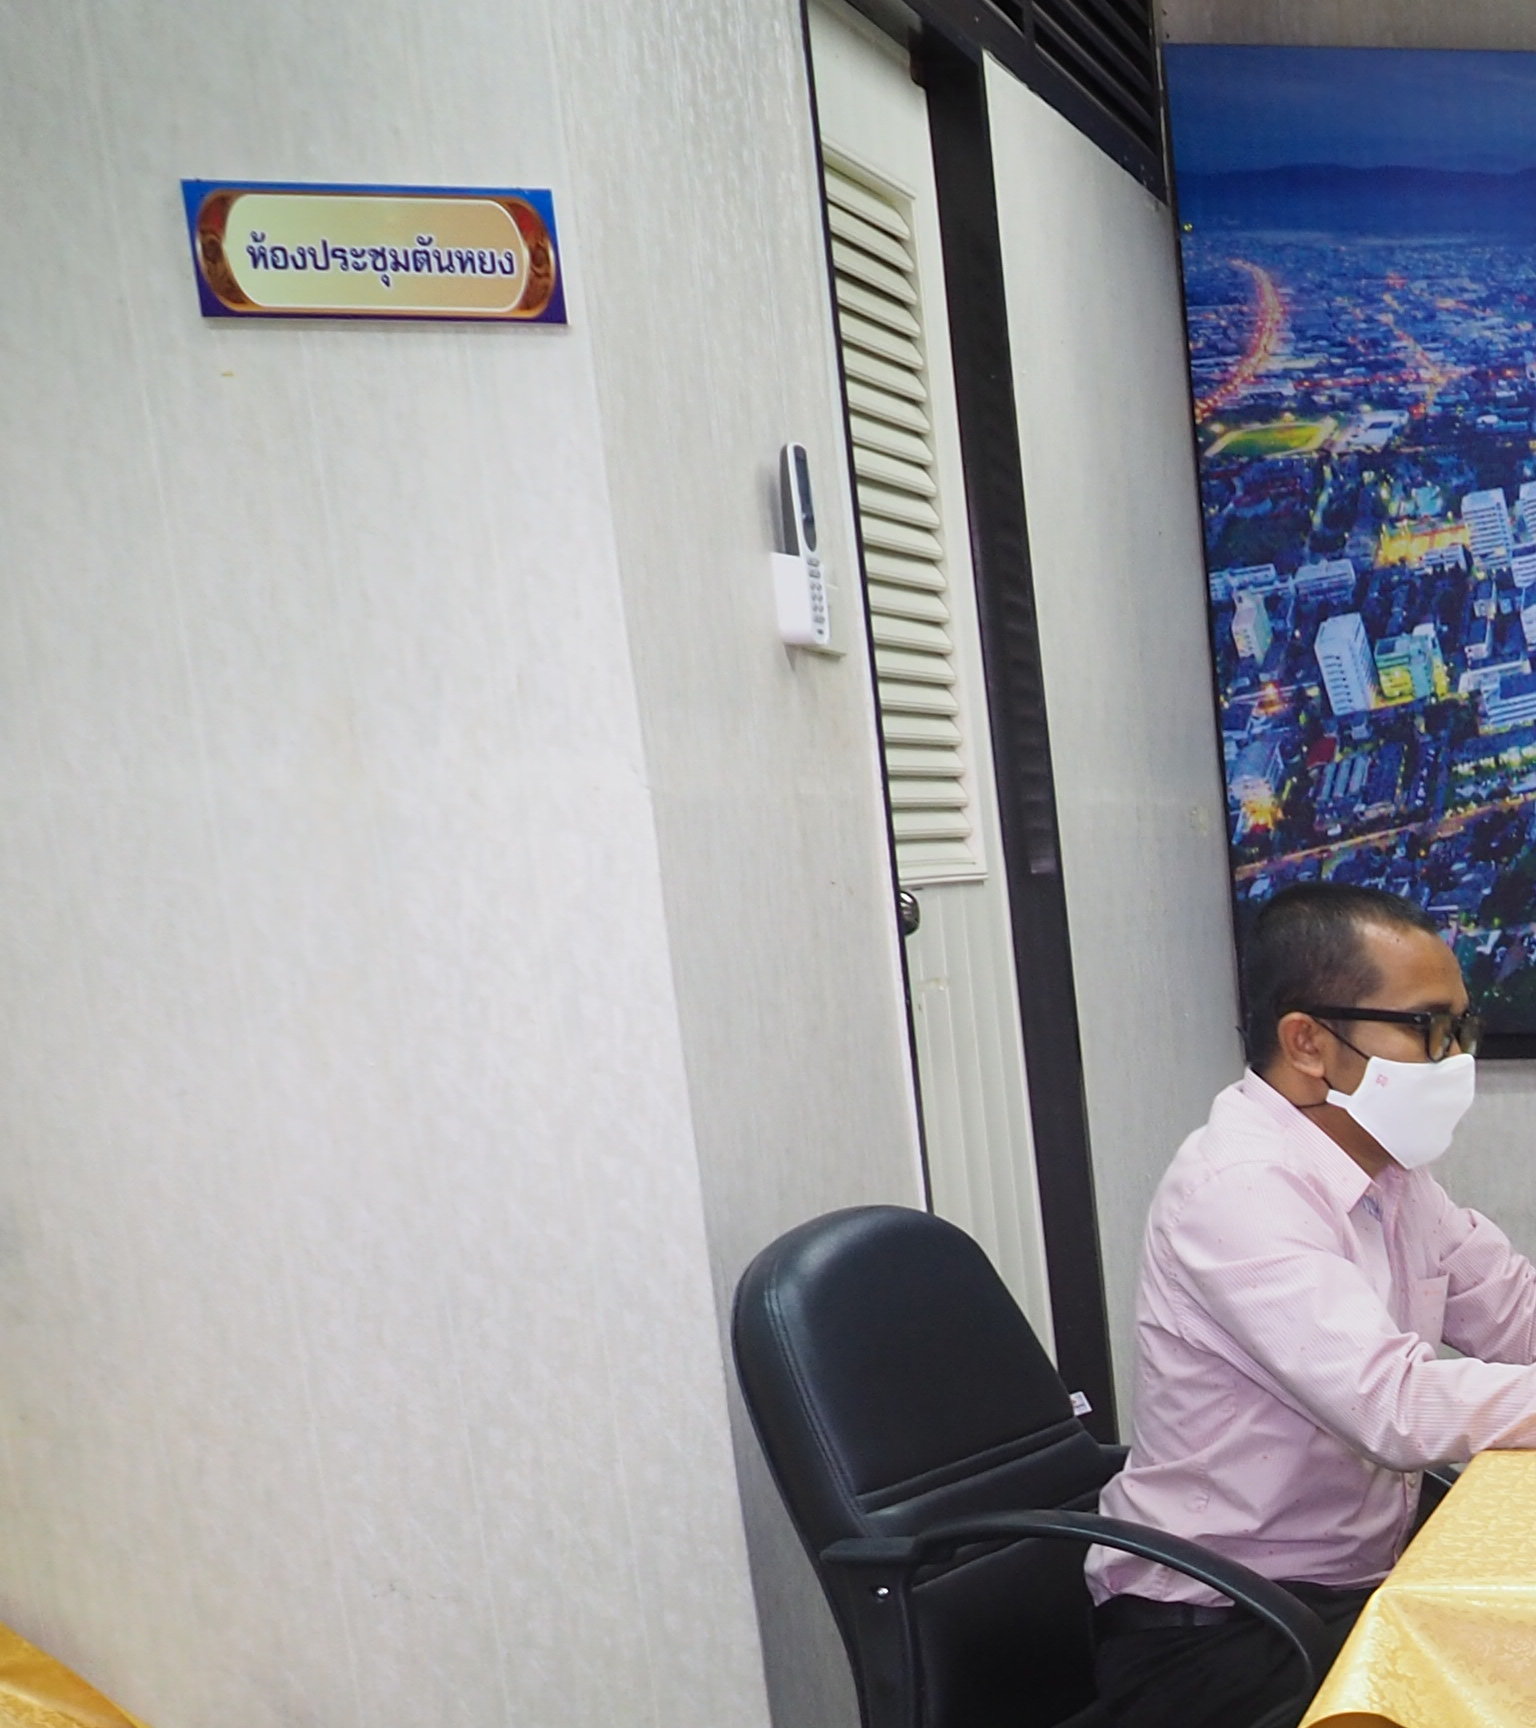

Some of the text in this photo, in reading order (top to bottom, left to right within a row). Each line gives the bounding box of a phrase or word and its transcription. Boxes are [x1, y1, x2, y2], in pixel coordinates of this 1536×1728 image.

[245, 231, 516, 288] ห้องประชุมตันหยง
